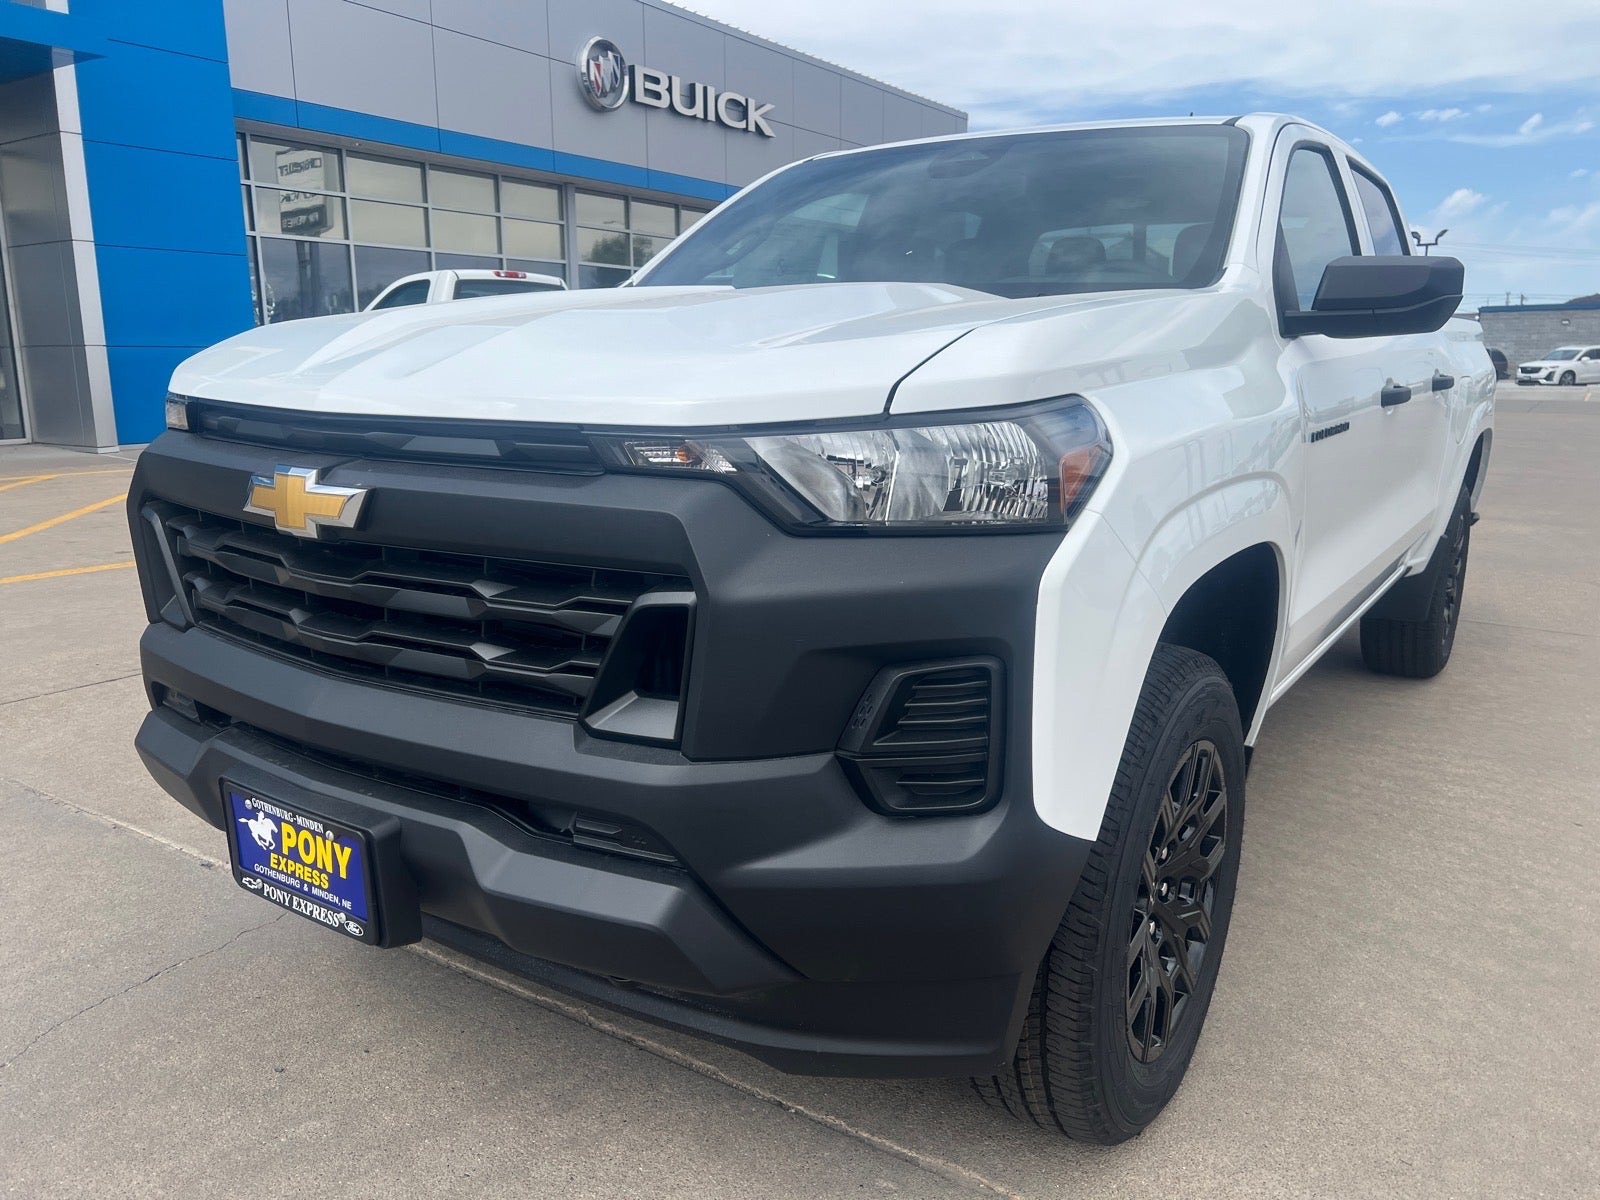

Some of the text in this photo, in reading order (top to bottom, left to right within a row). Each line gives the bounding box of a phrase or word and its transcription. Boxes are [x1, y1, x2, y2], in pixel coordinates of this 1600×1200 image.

[631, 64, 776, 138] BUICK
[251, 797, 324, 834] GOTHENBURG-MINDEN
[270, 852, 329, 889] EXPRESS
[281, 822, 352, 880] PONY
[254, 863, 352, 910] GOTHENBURG & MINDEN, NE
[263, 883, 291, 907] PONY
[292, 895, 340, 928] EXPRESS
